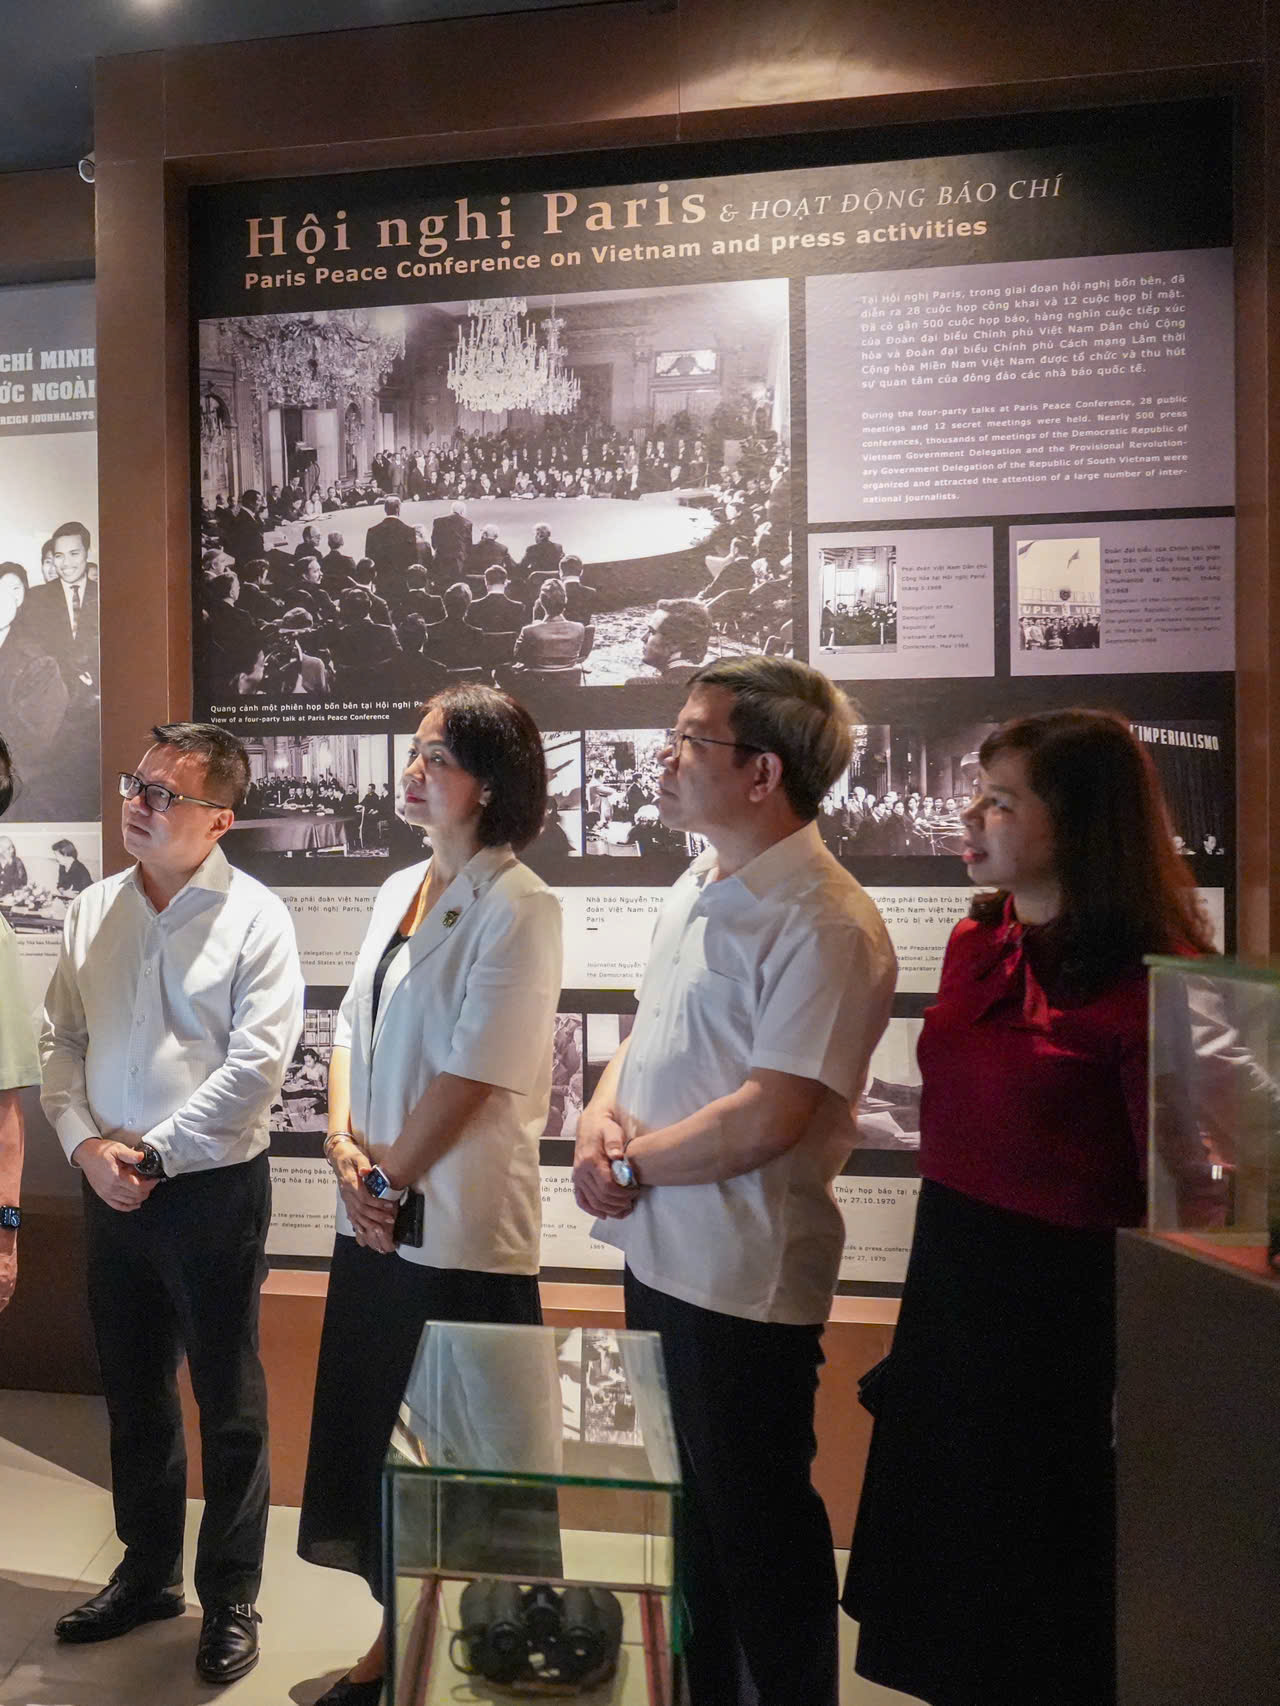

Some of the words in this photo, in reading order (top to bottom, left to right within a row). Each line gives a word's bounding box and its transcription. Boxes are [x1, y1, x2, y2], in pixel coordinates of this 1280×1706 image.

[245, 210, 350, 265] Hội
[377, 196, 514, 258] nghị
[543, 184, 707, 236] Paris
[719, 204, 737, 222] &
[749, 196, 831, 220] HOẠT
[841, 188, 925, 214] ĐỘNG
[937, 181, 996, 205] BÁO
[1008, 174, 1062, 200] CHÍ
[245, 270, 305, 289] Paris
[315, 267, 387, 284] Peace
[396, 253, 540, 277] Conference
[550, 252, 580, 267] on
[591, 243, 700, 263] Vietnam
[711, 234, 759, 254] and
[771, 232, 845, 254] press
[856, 220, 987, 243] activities
[40, 348, 96, 370] MINH
[32, 375, 96, 401] NGOÀI
[30, 411, 94, 422] JOURNALISTS
[917, 408, 967, 416] four-party
[1075, 399, 1135, 408] Conference,
[1156, 396, 1187, 404] public
[861, 439, 922, 447] conferences,
[925, 436, 975, 444] thousands
[1071, 428, 1128, 437] Democratic
[1130, 425, 1173, 433] Republic
[1177, 424, 1187, 432] of
[210, 705, 236, 713] Quang
[261, 704, 277, 712] một
[280, 703, 303, 711] phiên
[360, 702, 372, 710] tại
[375, 701, 389, 710] Hội
[392, 701, 410, 710] nghị
